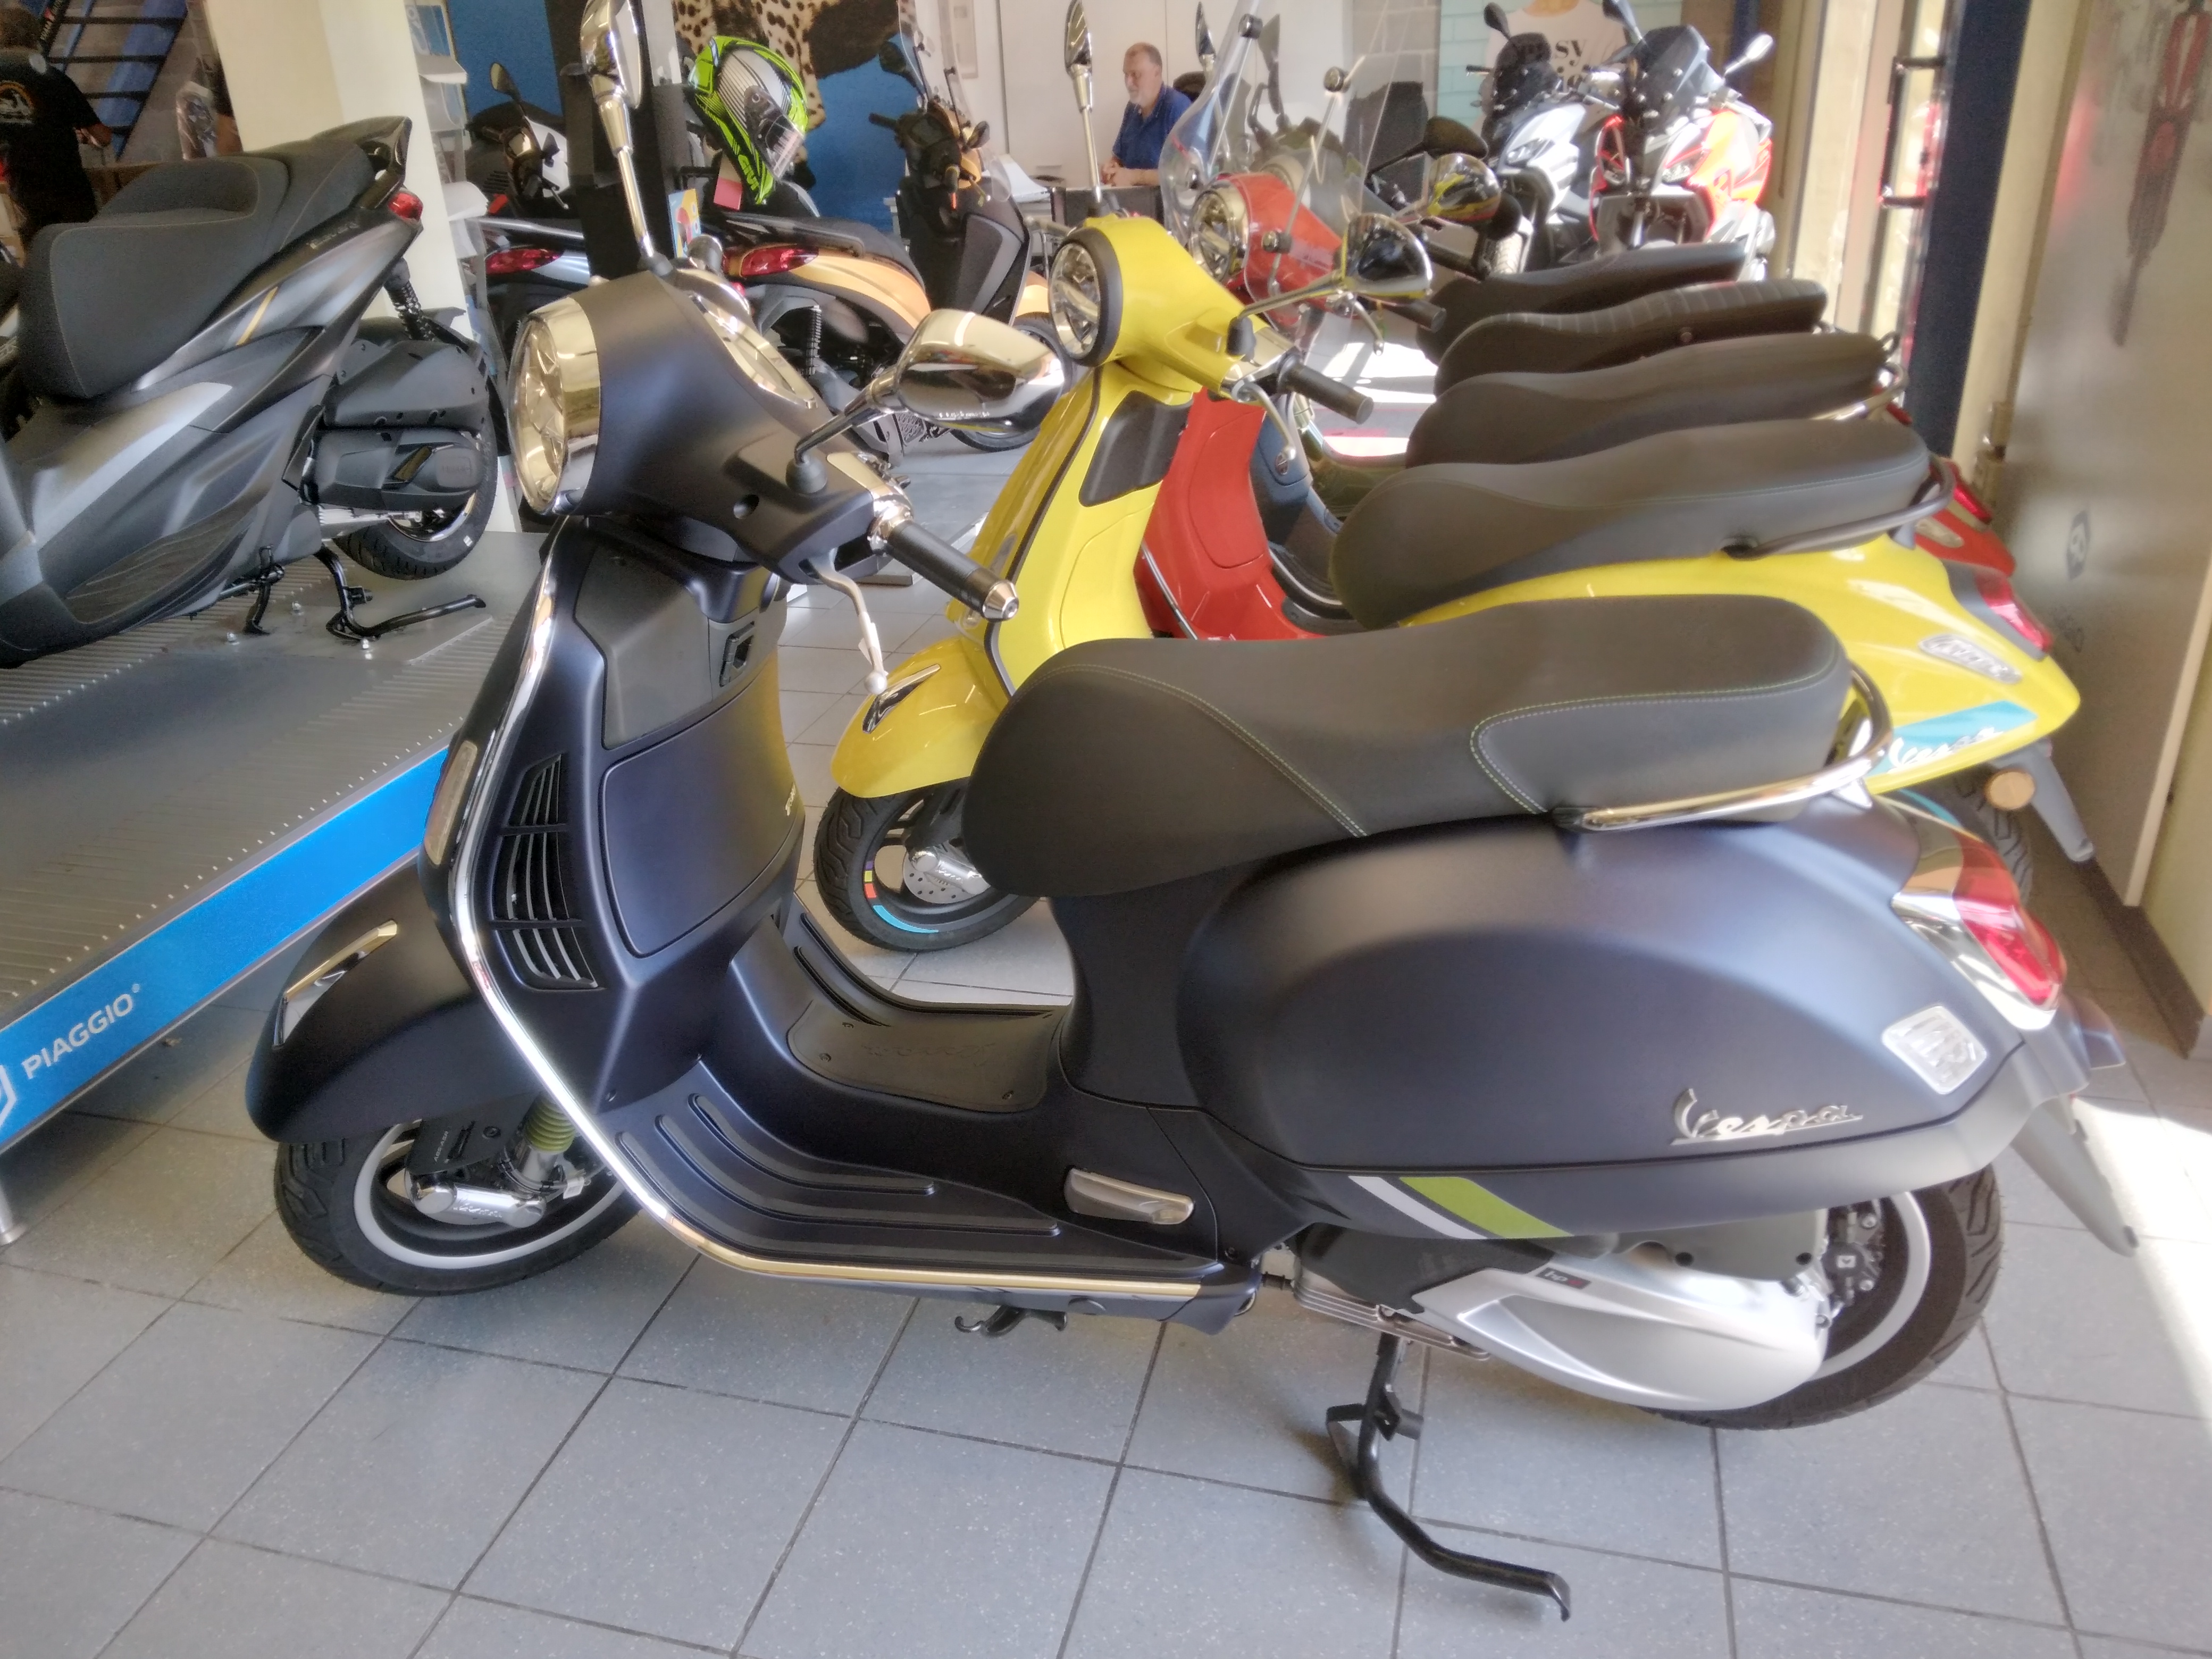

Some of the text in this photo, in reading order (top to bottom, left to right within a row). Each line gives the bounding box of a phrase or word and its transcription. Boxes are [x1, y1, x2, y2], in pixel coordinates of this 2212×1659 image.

[738, 154, 759, 191] GIVI
[1887, 727, 2004, 774] Vespa
[21, 994, 133, 1080] PIAGGIO
[1670, 1088, 1863, 1145] Vespa
